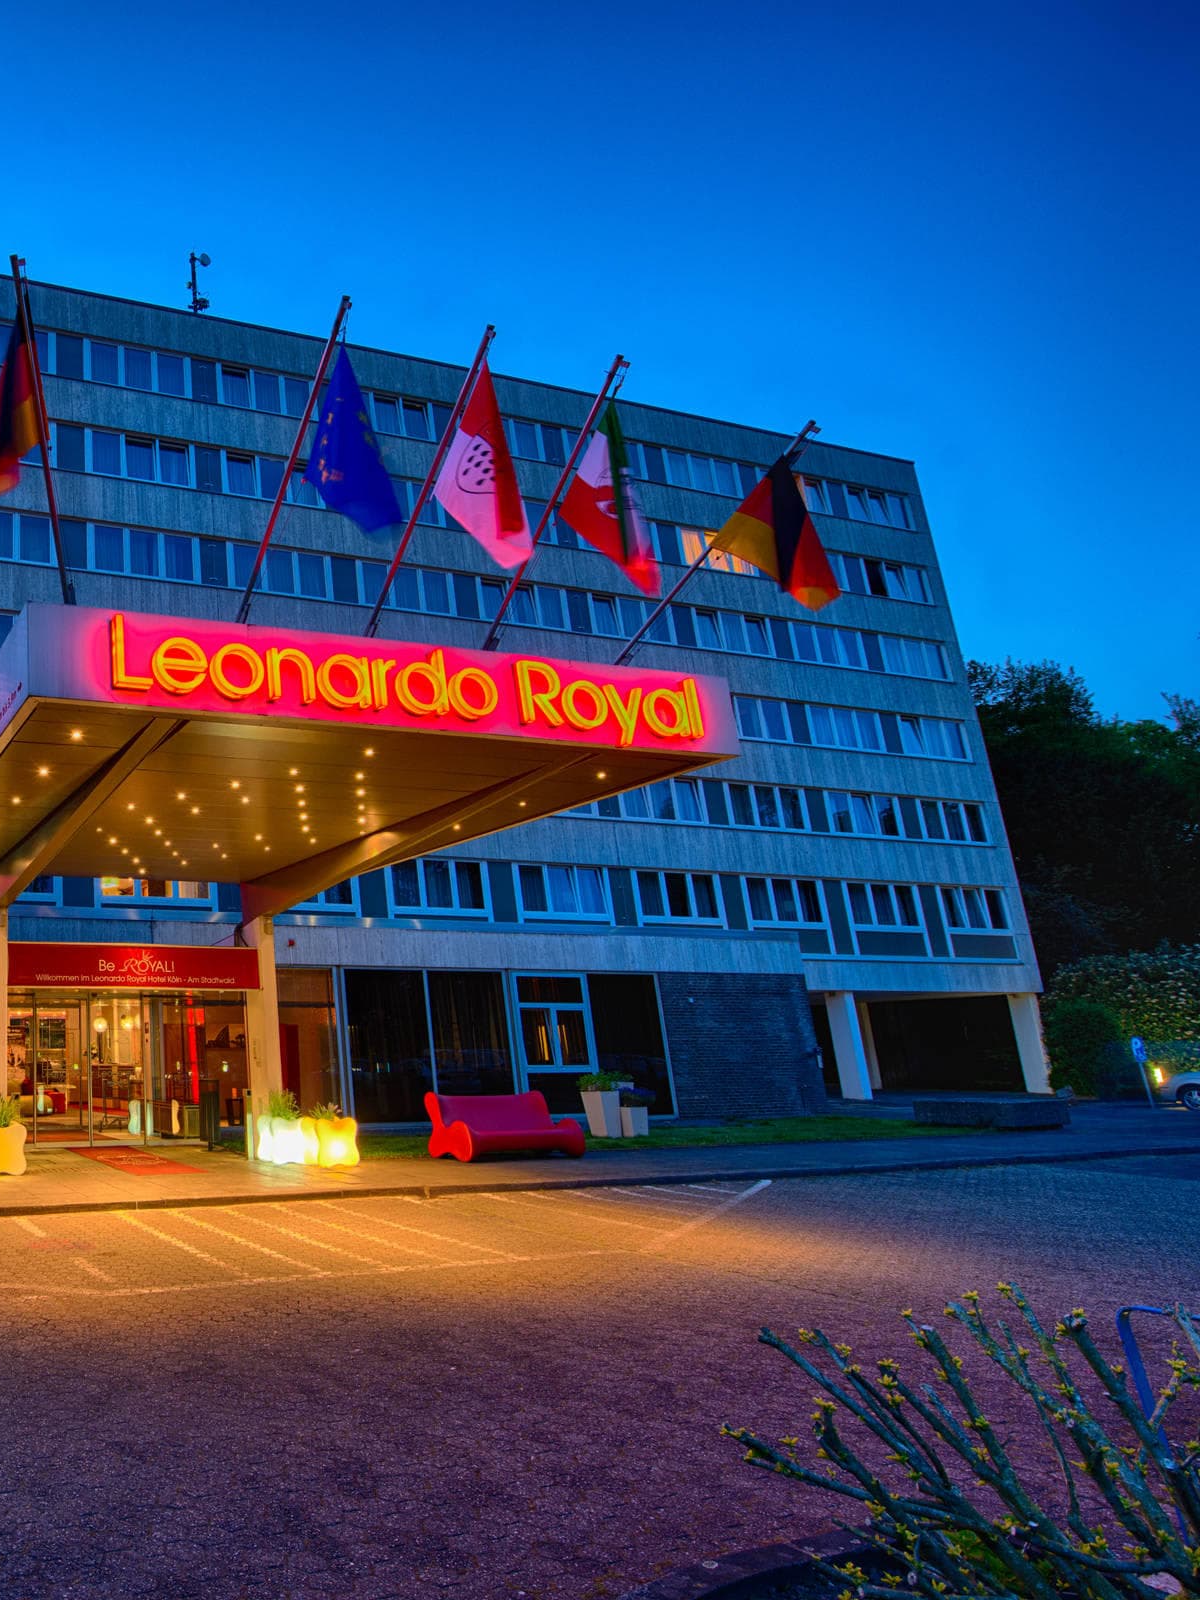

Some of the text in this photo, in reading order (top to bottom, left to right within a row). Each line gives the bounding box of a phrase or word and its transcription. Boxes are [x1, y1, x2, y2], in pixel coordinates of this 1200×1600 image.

[111, 613, 705, 748] Leonardo Royal
[98, 959, 116, 972] Be
[35, 974, 79, 982] Willkommen
[81, 974, 90, 982] im
[91, 975, 125, 983] Leonardo
[127, 976, 147, 984] Royal
[168, 975, 182, 983] Köln
[187, 976, 200, 984] Am
